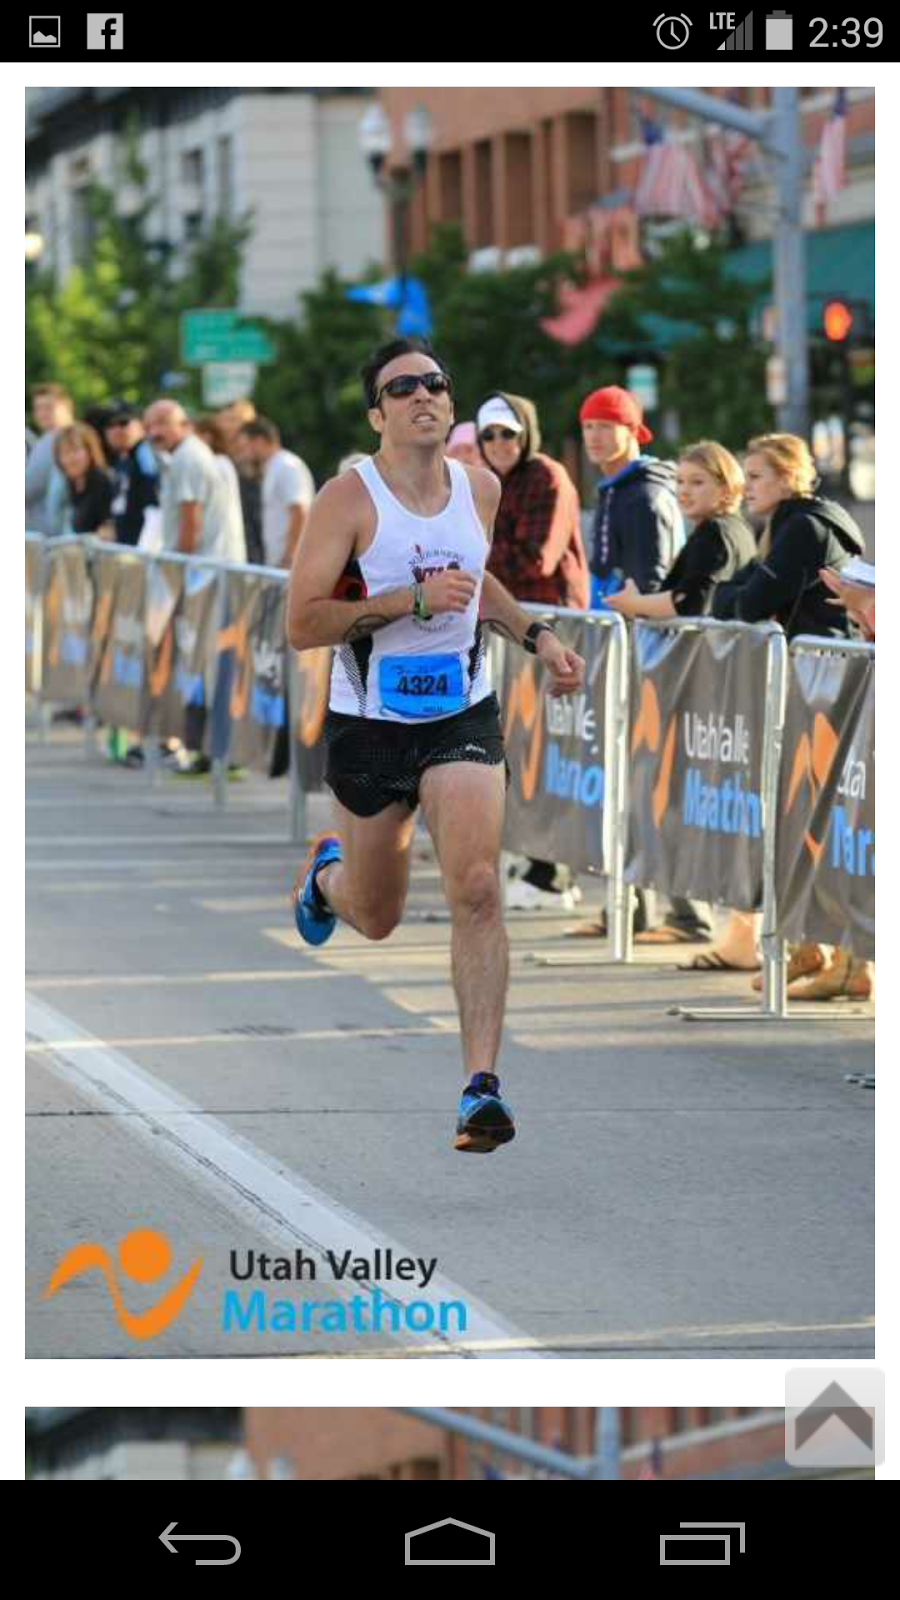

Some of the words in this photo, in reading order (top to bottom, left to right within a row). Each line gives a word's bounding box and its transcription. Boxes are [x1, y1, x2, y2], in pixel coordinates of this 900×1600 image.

[709, 12, 736, 30] LTE
[808, 16, 884, 48] 2:39
[397, 674, 448, 696] 4324
